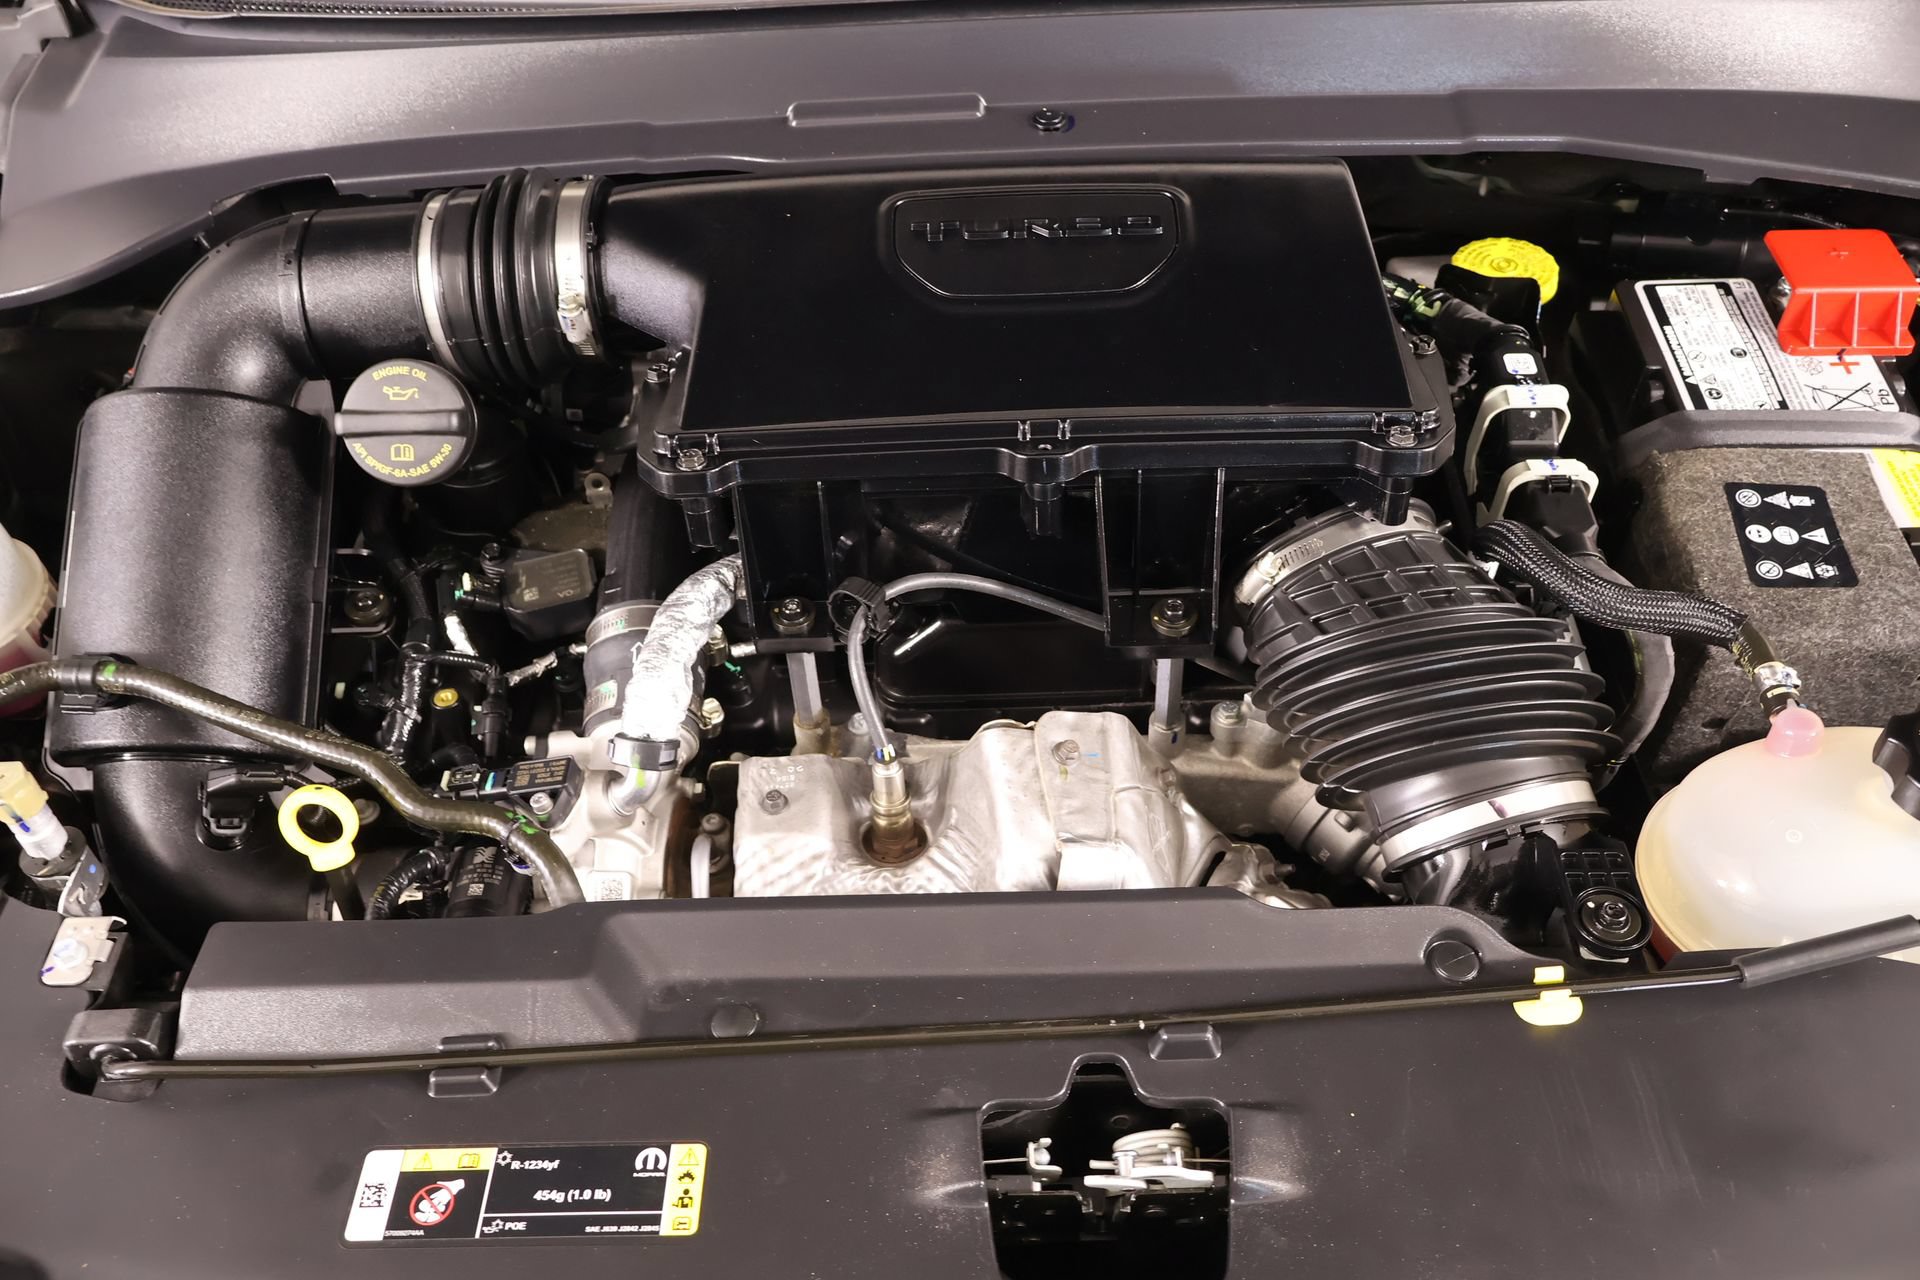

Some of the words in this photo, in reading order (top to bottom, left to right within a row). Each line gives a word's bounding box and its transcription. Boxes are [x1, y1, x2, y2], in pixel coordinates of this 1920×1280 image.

[910, 216, 1164, 241] TURBO
[372, 366, 410, 380] ENGINE
[411, 368, 427, 382] OIL
[352, 443, 367, 458] API
[510, 1159, 560, 1171] R-1234yf
[533, 1189, 566, 1203] 454g
[567, 1188, 592, 1203] (1.0
[593, 1188, 612, 1202] lb)
[504, 1222, 527, 1231] POE
